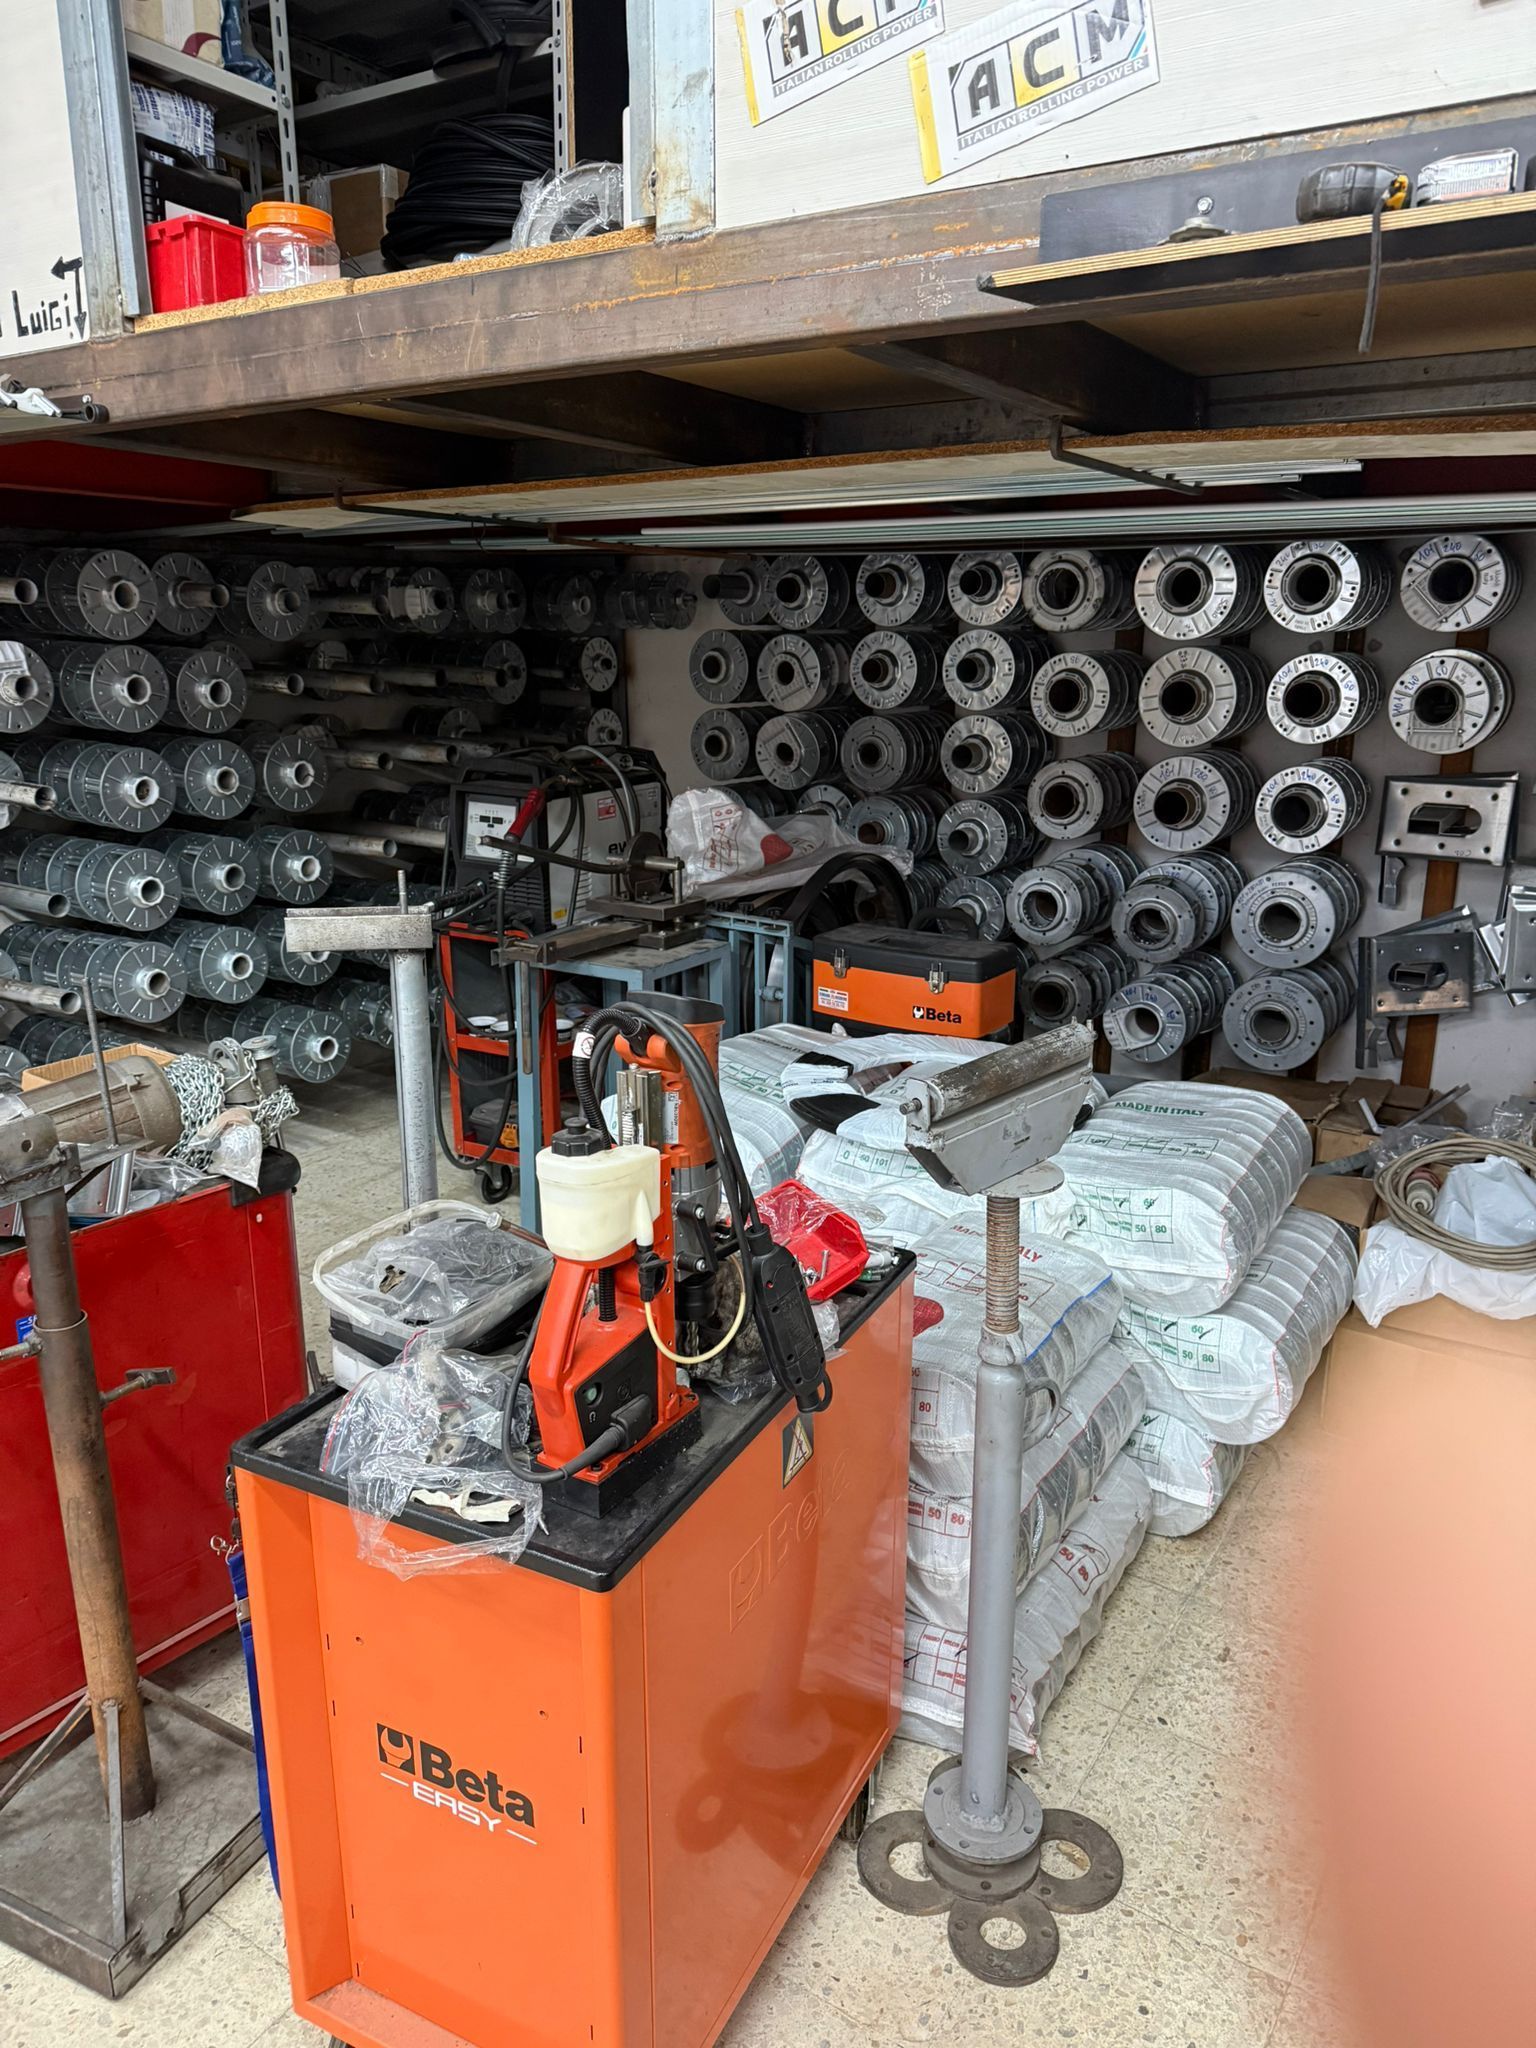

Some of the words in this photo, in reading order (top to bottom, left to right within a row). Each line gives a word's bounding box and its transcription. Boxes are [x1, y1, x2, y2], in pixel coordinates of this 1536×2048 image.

[781, 0, 898, 67] AC
[773, 63, 825, 98] ITALIAN
[825, 36, 881, 70] ROLLING
[882, 9, 934, 43] POWER
[967, 0, 1131, 119] ACM
[958, 115, 1017, 150] ITALIAN
[1018, 83, 1084, 122] ROLLING
[1086, 57, 1146, 92] POWER
[1442, 541, 1463, 553] 240
[1403, 674, 1420, 691] 240
[926, 1007, 962, 1024] Beta
[1115, 1101, 1151, 1113] MADE
[1153, 1105, 1170, 1114] IN
[1170, 1106, 1208, 1116] ITALY
[1135, 1224, 1147, 1233] 50
[1154, 1225, 1167, 1234] 80
[1191, 1324, 1204, 1334] 60
[1182, 1350, 1194, 1360] 50
[1201, 1353, 1214, 1363] 80
[918, 1401, 932, 1413] 80
[927, 1506, 942, 1520] 50
[950, 1512, 965, 1526] 80
[419, 1740, 536, 1829] Beta
[412, 1780, 502, 1833] EASY
